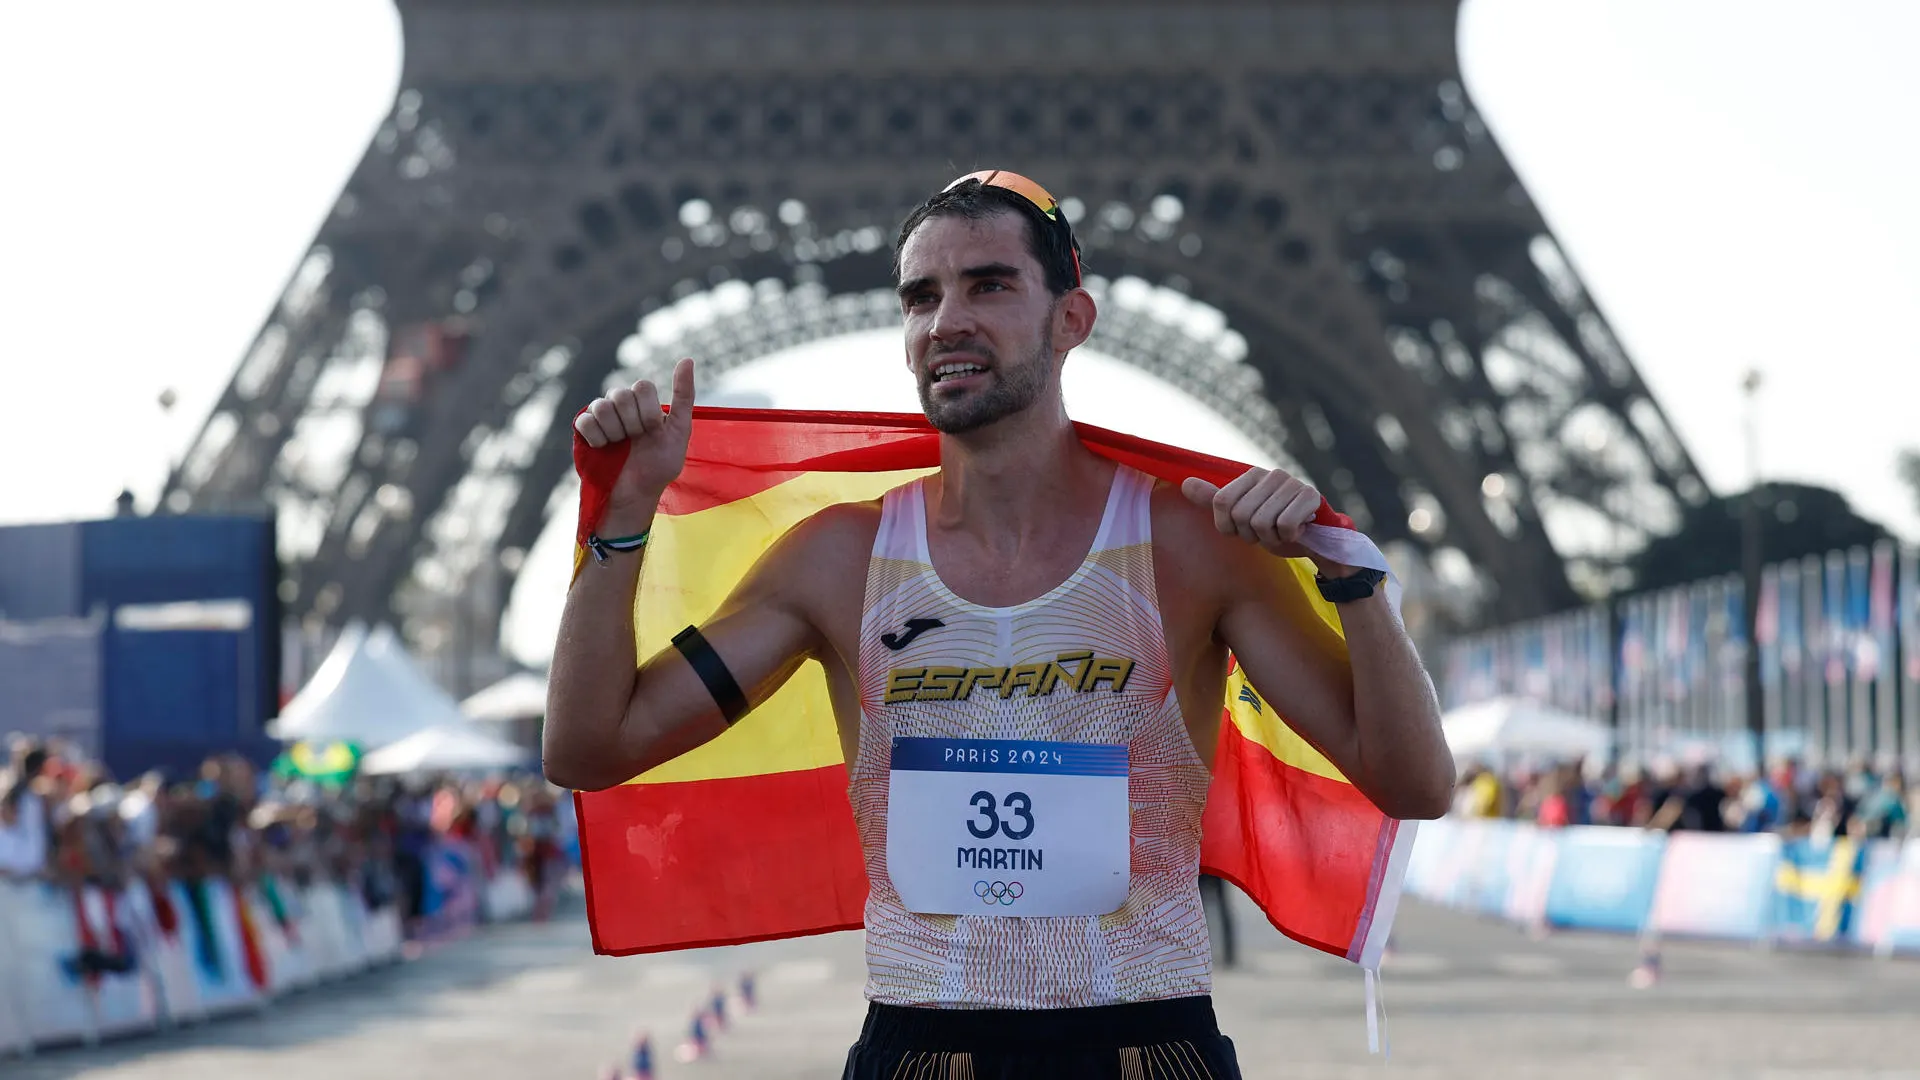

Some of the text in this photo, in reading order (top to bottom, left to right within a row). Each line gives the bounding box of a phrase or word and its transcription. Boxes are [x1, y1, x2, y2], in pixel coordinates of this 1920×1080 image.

[884, 650, 1136, 705] ESPAÑA
[1008, 749, 1062, 765] 2024
[966, 790, 1035, 840] 33
[957, 847, 1043, 870] MARTIN
